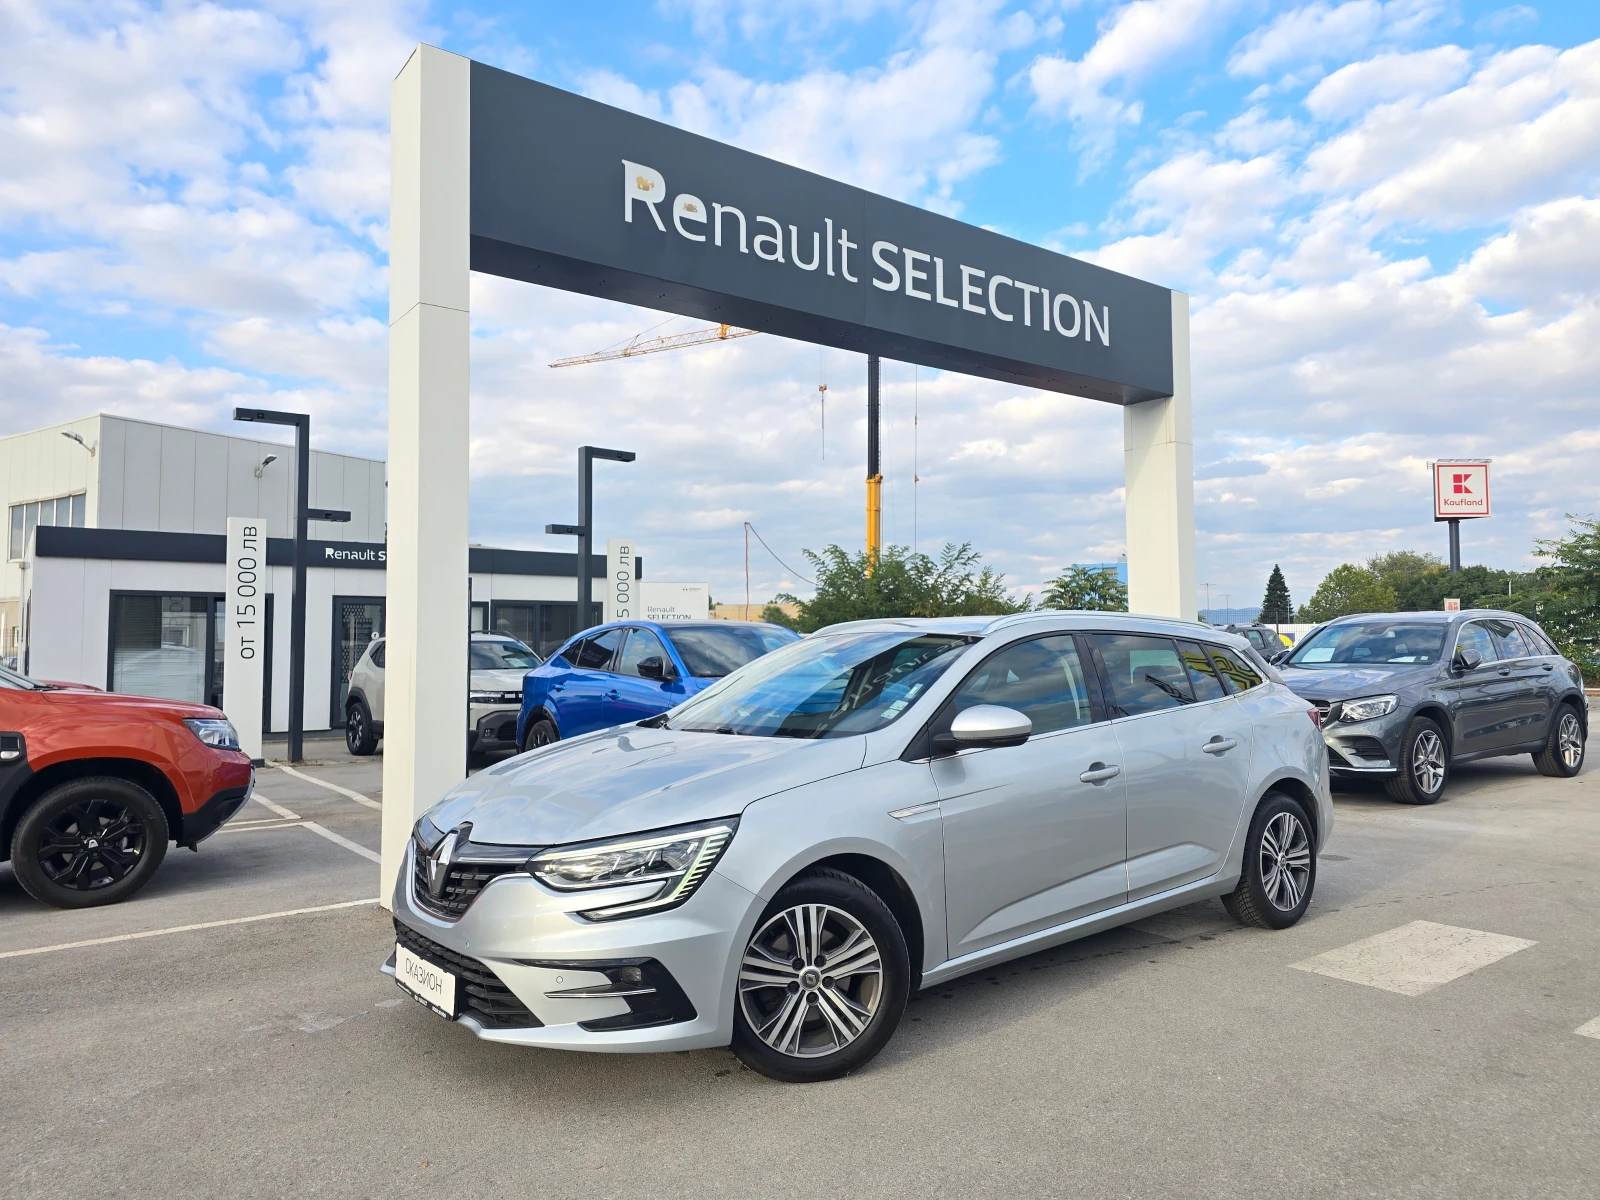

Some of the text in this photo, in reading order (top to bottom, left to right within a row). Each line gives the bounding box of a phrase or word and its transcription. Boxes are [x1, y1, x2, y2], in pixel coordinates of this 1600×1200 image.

[621, 159, 1110, 347] Renault SELECTION
[1443, 498, 1483, 506] Kaufland
[325, 547, 387, 561] Renault S
[237, 557, 257, 597] 000
[617, 571, 630, 603] 000
[236, 604, 256, 628] 15
